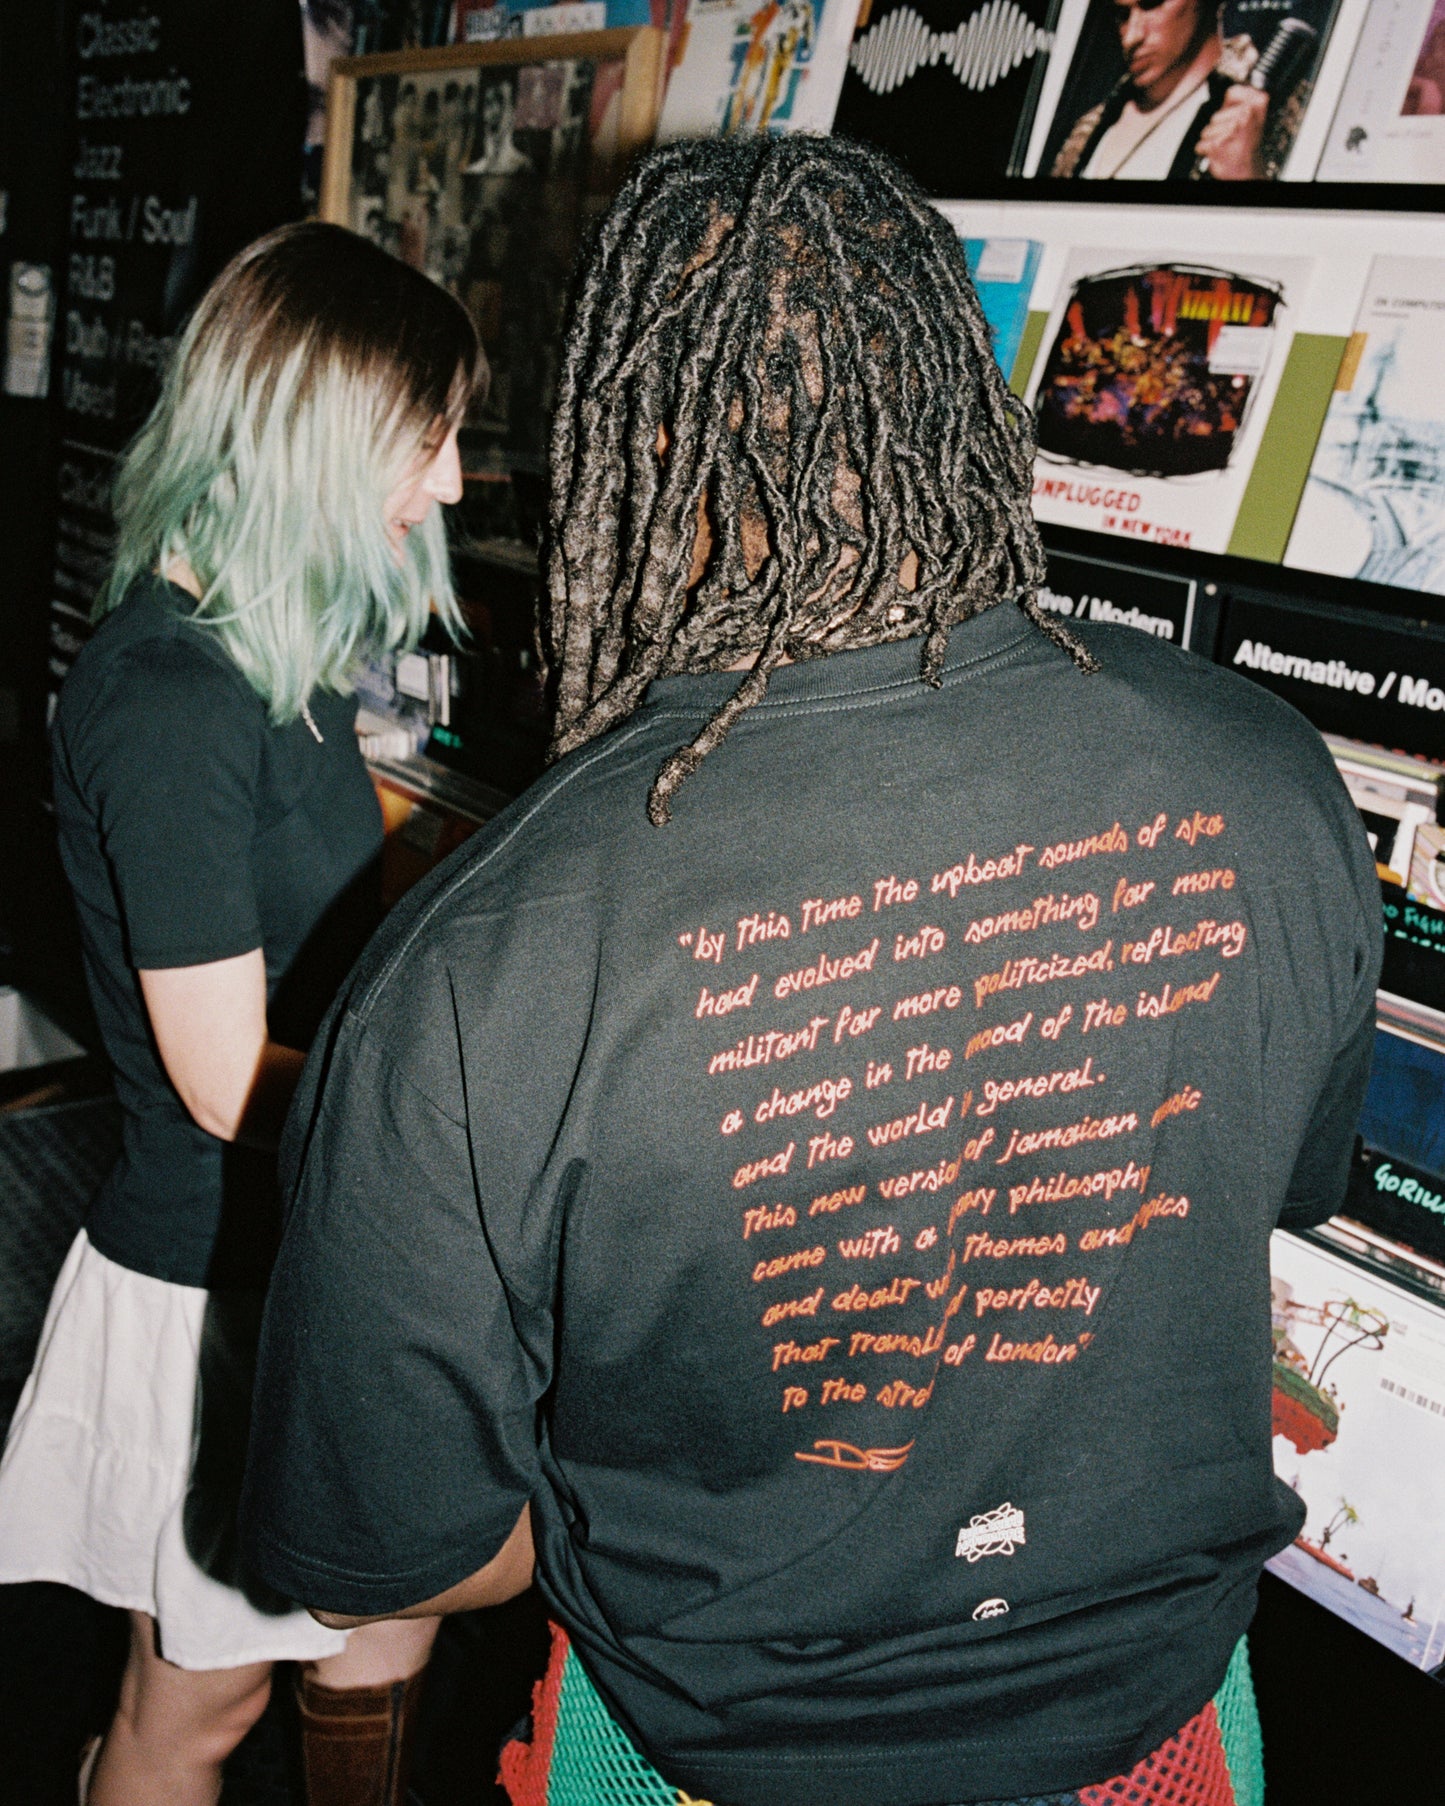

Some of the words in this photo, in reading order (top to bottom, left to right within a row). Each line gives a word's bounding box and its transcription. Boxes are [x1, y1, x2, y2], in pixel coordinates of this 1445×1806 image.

[76, 66, 191, 119] Electronic
[142, 194, 198, 245] Soul
[1032, 478, 1141, 512] UNPLUGGED
[1089, 597, 1175, 640] Modern
[1233, 638, 1376, 696] Alternative
[1377, 671, 1396, 699] /
[1398, 674, 1445, 711] Mo
[930, 844, 1035, 898] upbeat
[1038, 821, 1129, 868] sounds
[1137, 812, 1168, 848] of
[1175, 811, 1225, 846] ska
[695, 974, 759, 1018] had
[774, 938, 879, 998] evolved
[894, 925, 945, 962] into
[964, 892, 1099, 944] something
[1112, 877, 1154, 912] far
[1172, 869, 1235, 896] more
[1404, 906, 1445, 935] FIGH
[708, 1017, 829, 1075] militant
[833, 1005, 882, 1044] far
[893, 986, 962, 1020] more
[1121, 919, 1248, 965] reflecting
[720, 1109, 744, 1135] a
[754, 1077, 852, 1122] change
[866, 1060, 892, 1089] in
[964, 1011, 1034, 1060] mood
[1040, 1005, 1073, 1040] of
[1136, 971, 1221, 1018] island
[732, 1140, 796, 1188] and
[867, 1096, 954, 1146] world
[808, 1184, 867, 1217] new
[963, 1126, 995, 1161] of
[996, 1111, 1138, 1165] jamaican
[751, 1245, 827, 1282] came
[837, 1226, 901, 1259] with
[914, 1225, 939, 1251] a
[1009, 1161, 1151, 1215] philosophy
[761, 1286, 824, 1327] and
[831, 1277, 922, 1312] dealt
[962, 1231, 1067, 1264] themes
[1079, 1213, 1138, 1251] and
[975, 1277, 1102, 1318] perfectly
[782, 1385, 808, 1413] to
[943, 1332, 977, 1367] of
